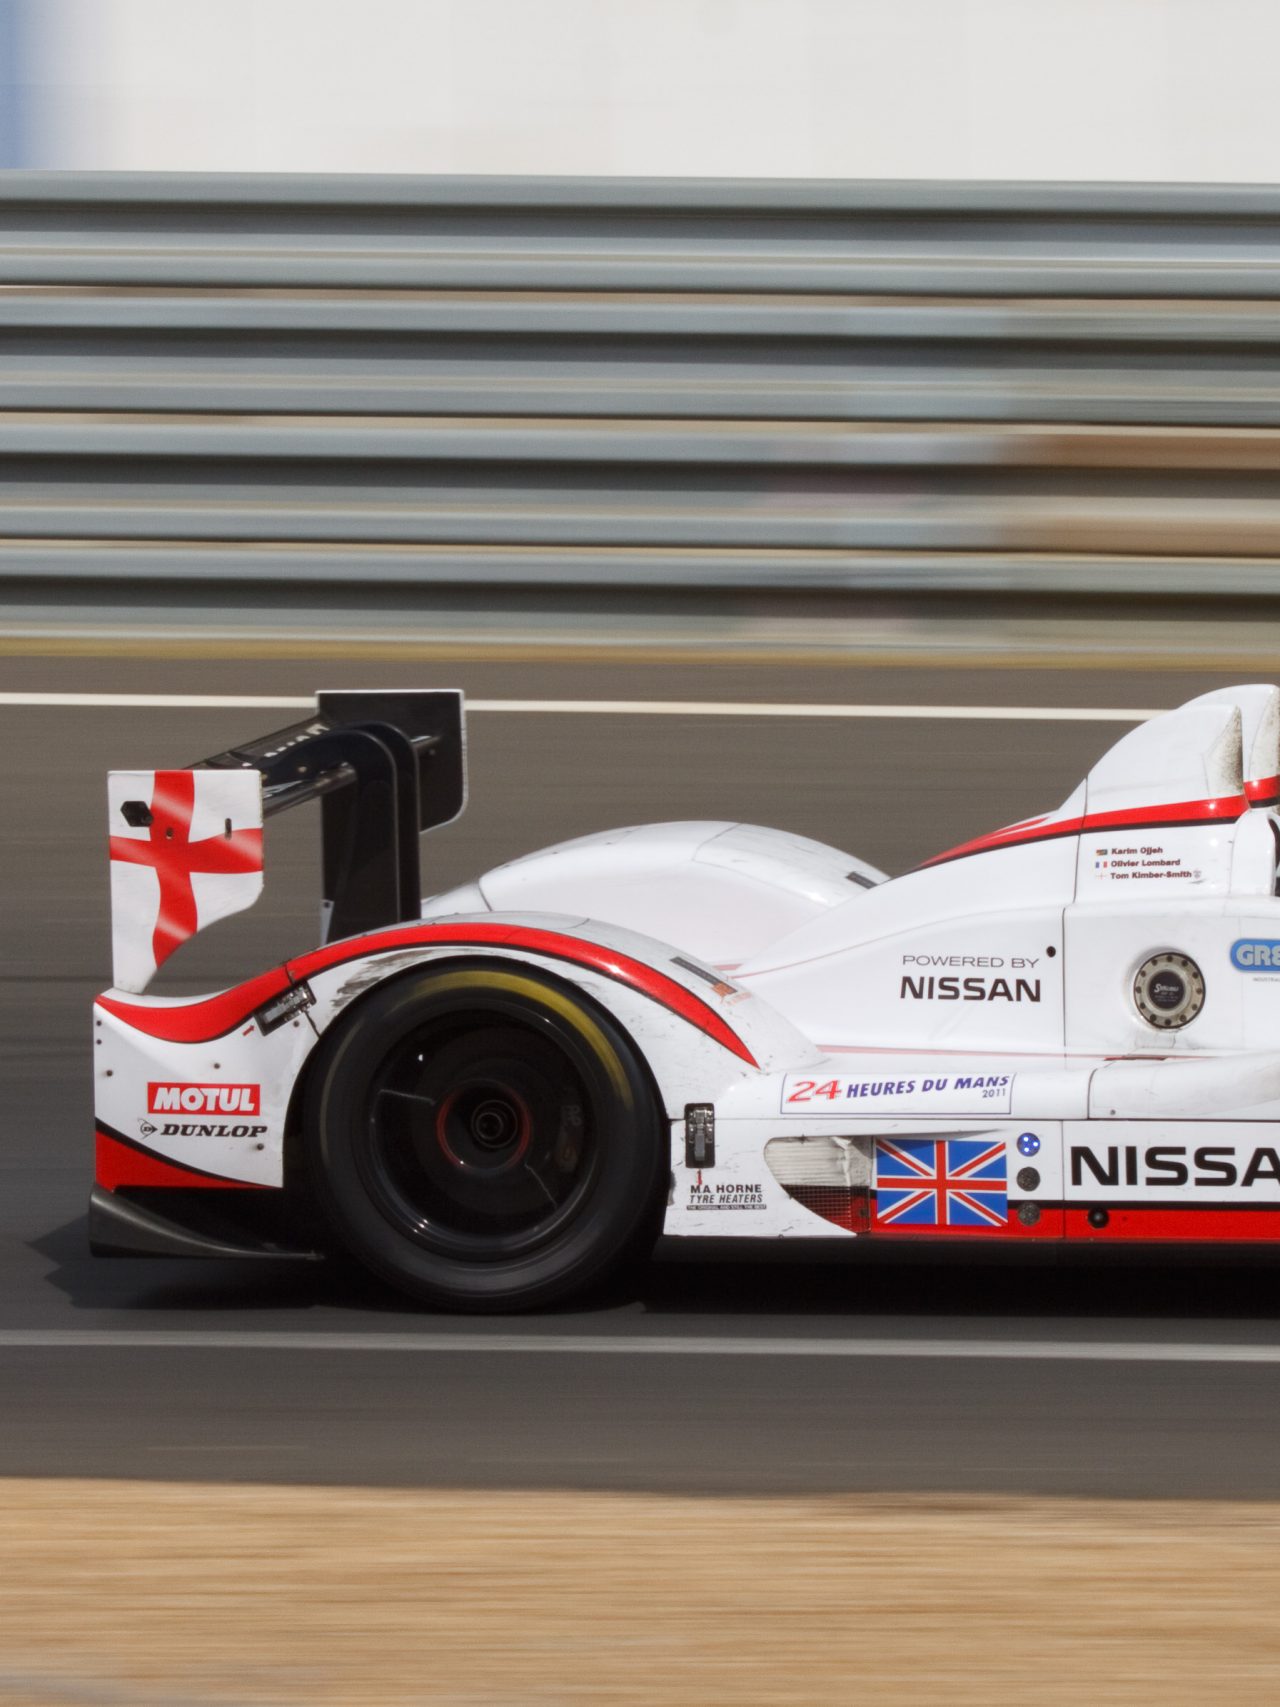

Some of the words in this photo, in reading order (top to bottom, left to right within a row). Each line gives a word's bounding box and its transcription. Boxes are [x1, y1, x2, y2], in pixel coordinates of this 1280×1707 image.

[1142, 859, 1181, 867] Lombard
[1132, 870, 1192, 878] Kimber-Smith
[902, 955, 1004, 968] POWERED
[1011, 958, 1040, 968] BY
[900, 976, 1041, 1002] NISSAN
[787, 1079, 842, 1103] 24
[846, 1080, 916, 1098] HEURES
[921, 1078, 948, 1092] DU
[953, 1075, 1010, 1090] MANS
[982, 1088, 1006, 1098] 2011
[153, 1087, 255, 1112] MOTUL
[160, 1124, 268, 1138] DUNLOP
[716, 1184, 762, 1193] HORNE
[690, 1195, 715, 1204] TYRE
[719, 1194, 763, 1204] HEATERS
